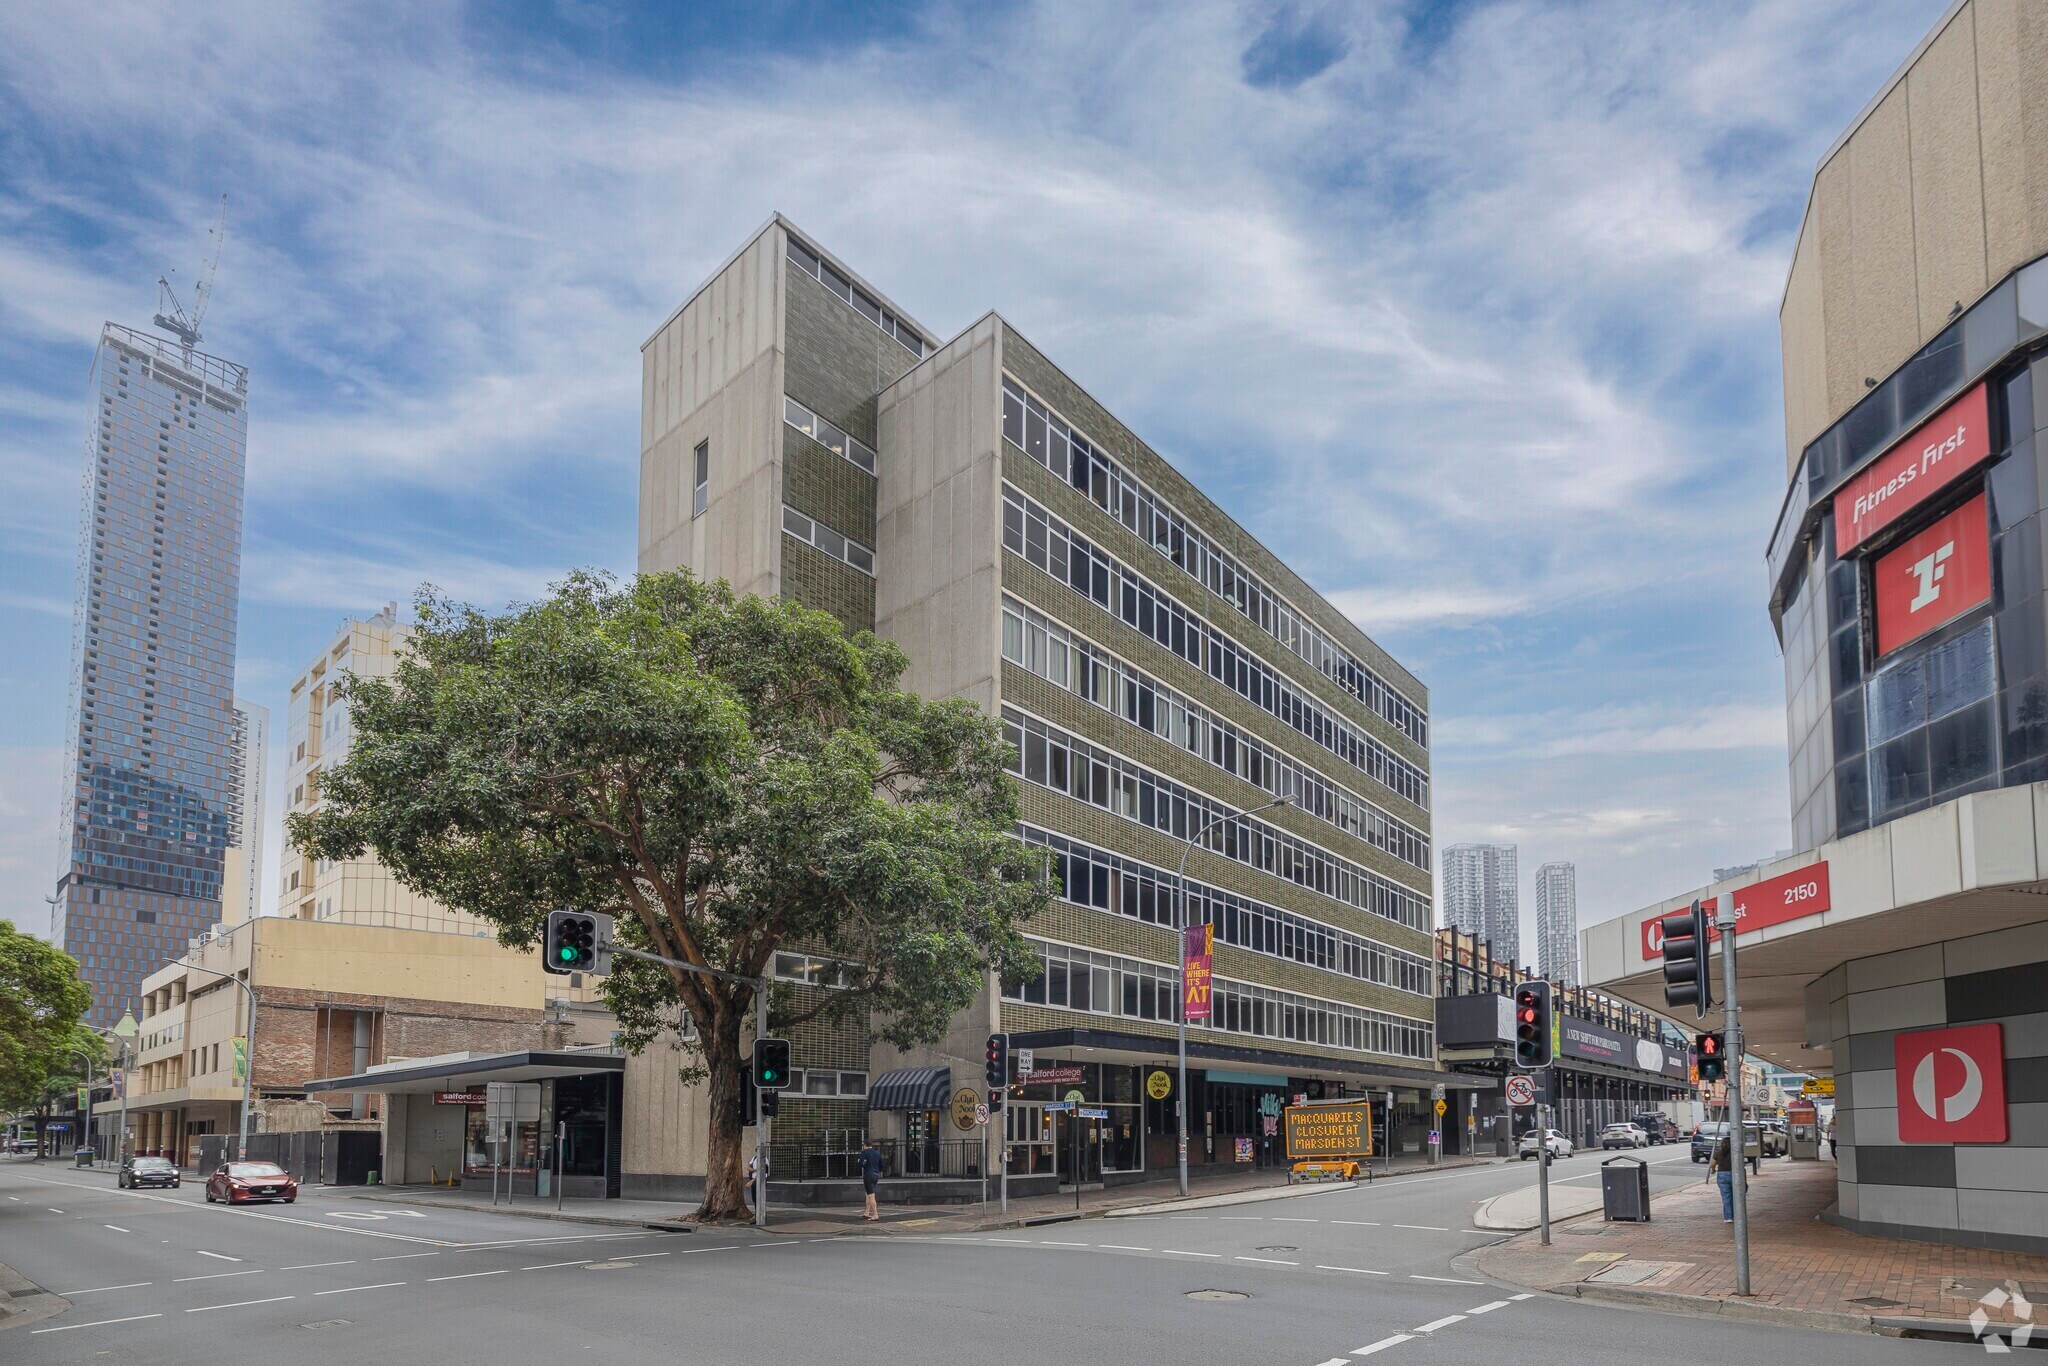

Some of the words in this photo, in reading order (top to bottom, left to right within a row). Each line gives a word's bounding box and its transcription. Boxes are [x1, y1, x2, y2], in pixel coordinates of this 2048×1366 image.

[1853, 462, 1917, 524] Fitness
[1921, 425, 1966, 476] First
[1783, 881, 1818, 905] 2150
[1187, 962, 1201, 970] LIVE
[1186, 969, 1210, 978] WHERE
[1187, 978, 1200, 986] IT'S
[1055, 1069, 1081, 1078] college
[961, 1094, 975, 1104] Chai
[1291, 1112, 1354, 1125] MACQUARIE
[1355, 1111, 1363, 1122] S
[1296, 1124, 1345, 1137] CLOSURE
[1346, 1124, 1359, 1135] AT
[1295, 1137, 1345, 1150] MARSDEN
[1347, 1137, 1361, 1148] ST
